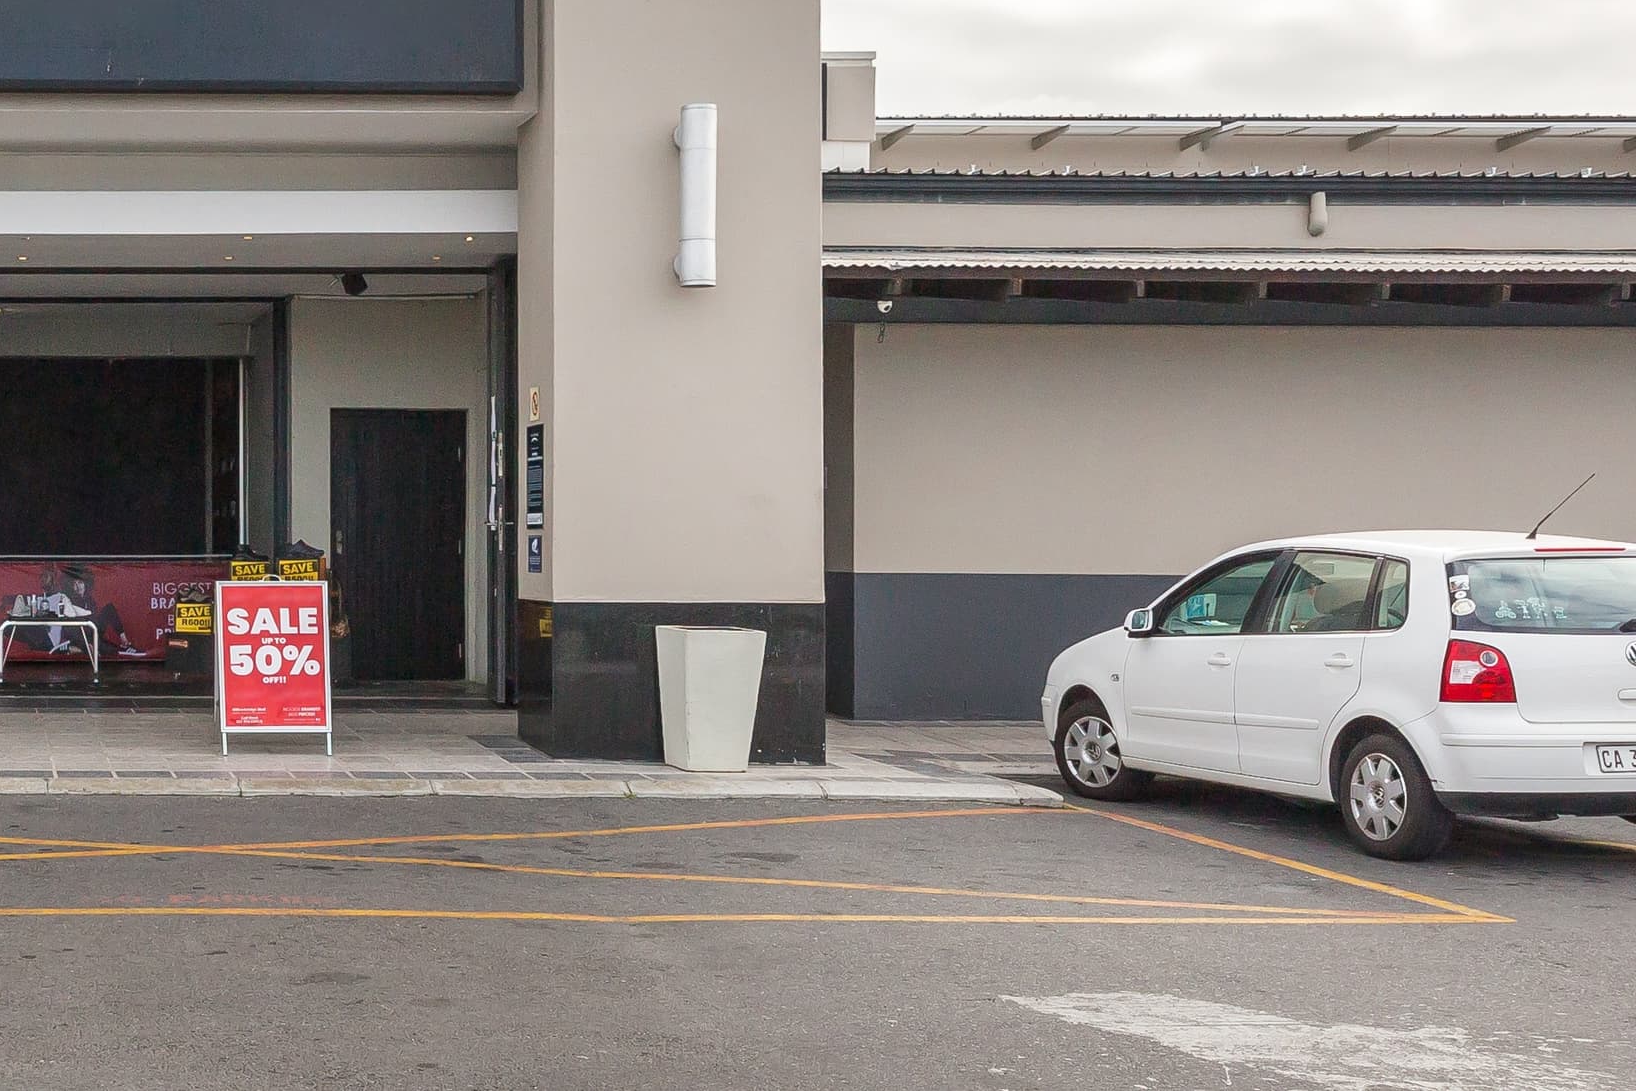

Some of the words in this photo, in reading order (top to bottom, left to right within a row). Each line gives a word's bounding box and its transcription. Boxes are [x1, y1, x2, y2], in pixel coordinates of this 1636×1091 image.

[235, 564, 265, 575] SAVE
[283, 562, 314, 575] SAVE
[180, 607, 211, 617] SAVE
[226, 607, 318, 635] SALE
[229, 645, 321, 676] 50%
[262, 676, 287, 684] OFF!!
[1601, 749, 1625, 769] CA
